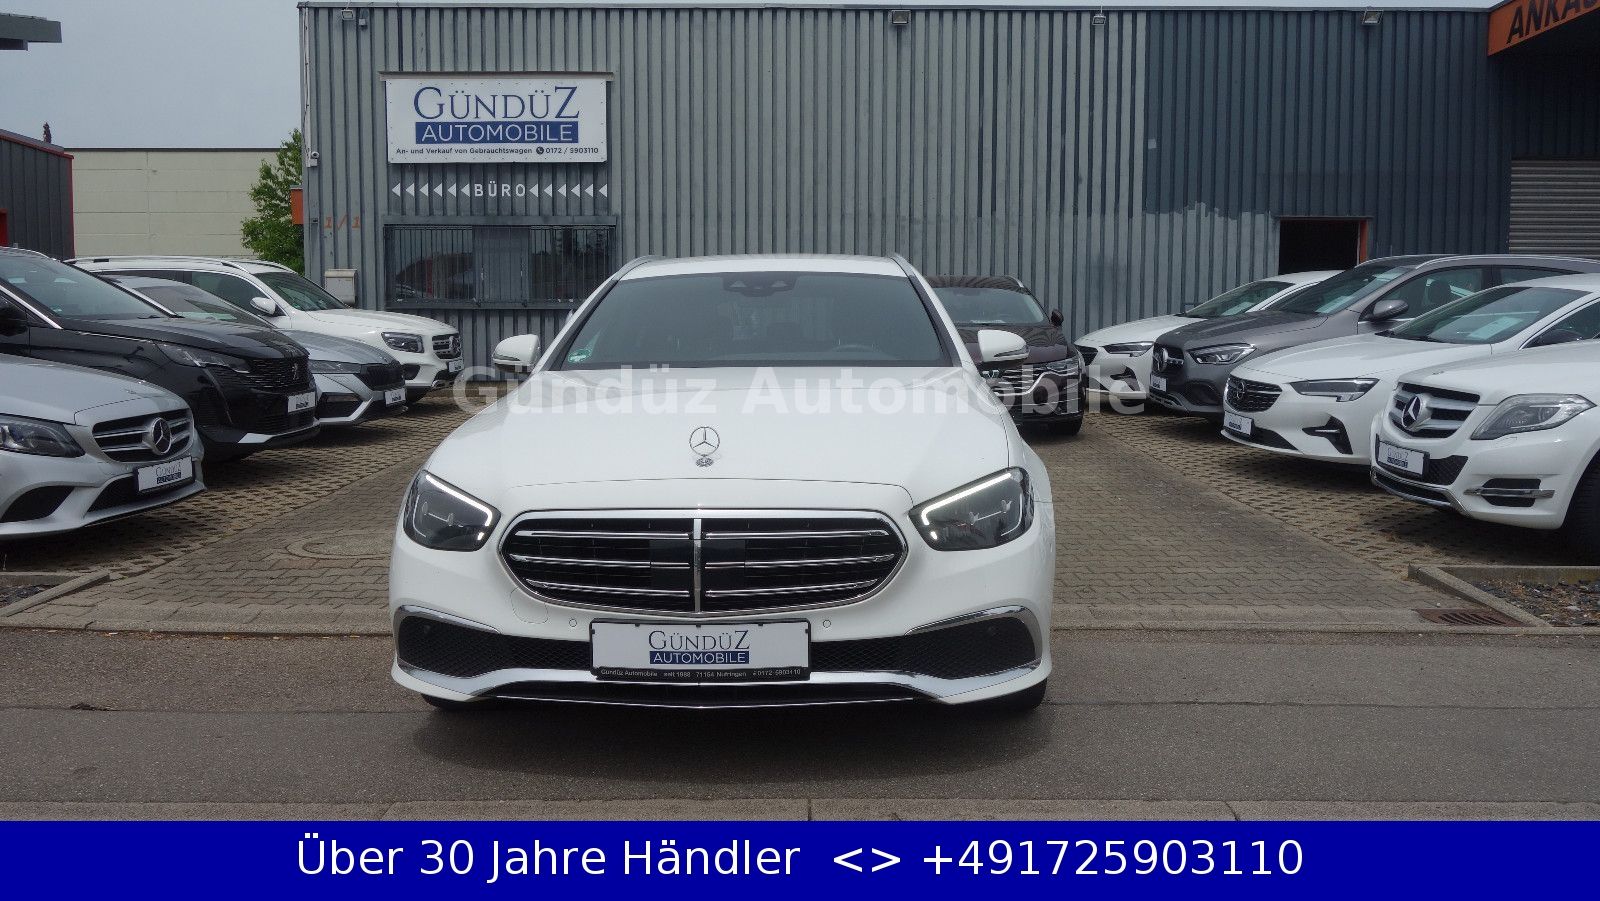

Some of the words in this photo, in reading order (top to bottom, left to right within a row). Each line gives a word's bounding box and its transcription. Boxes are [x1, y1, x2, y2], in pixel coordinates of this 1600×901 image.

[1506, 0, 1597, 45] ANKA
[413, 86, 580, 120] GÜNDÜZ
[421, 124, 573, 142] AUTOMOBILE
[469, 147, 533, 155] Gebrauchtswagen
[474, 181, 526, 198] BÜRO
[648, 630, 750, 651] GÜNDÜZ
[653, 652, 746, 664] AUTOMOBILE
